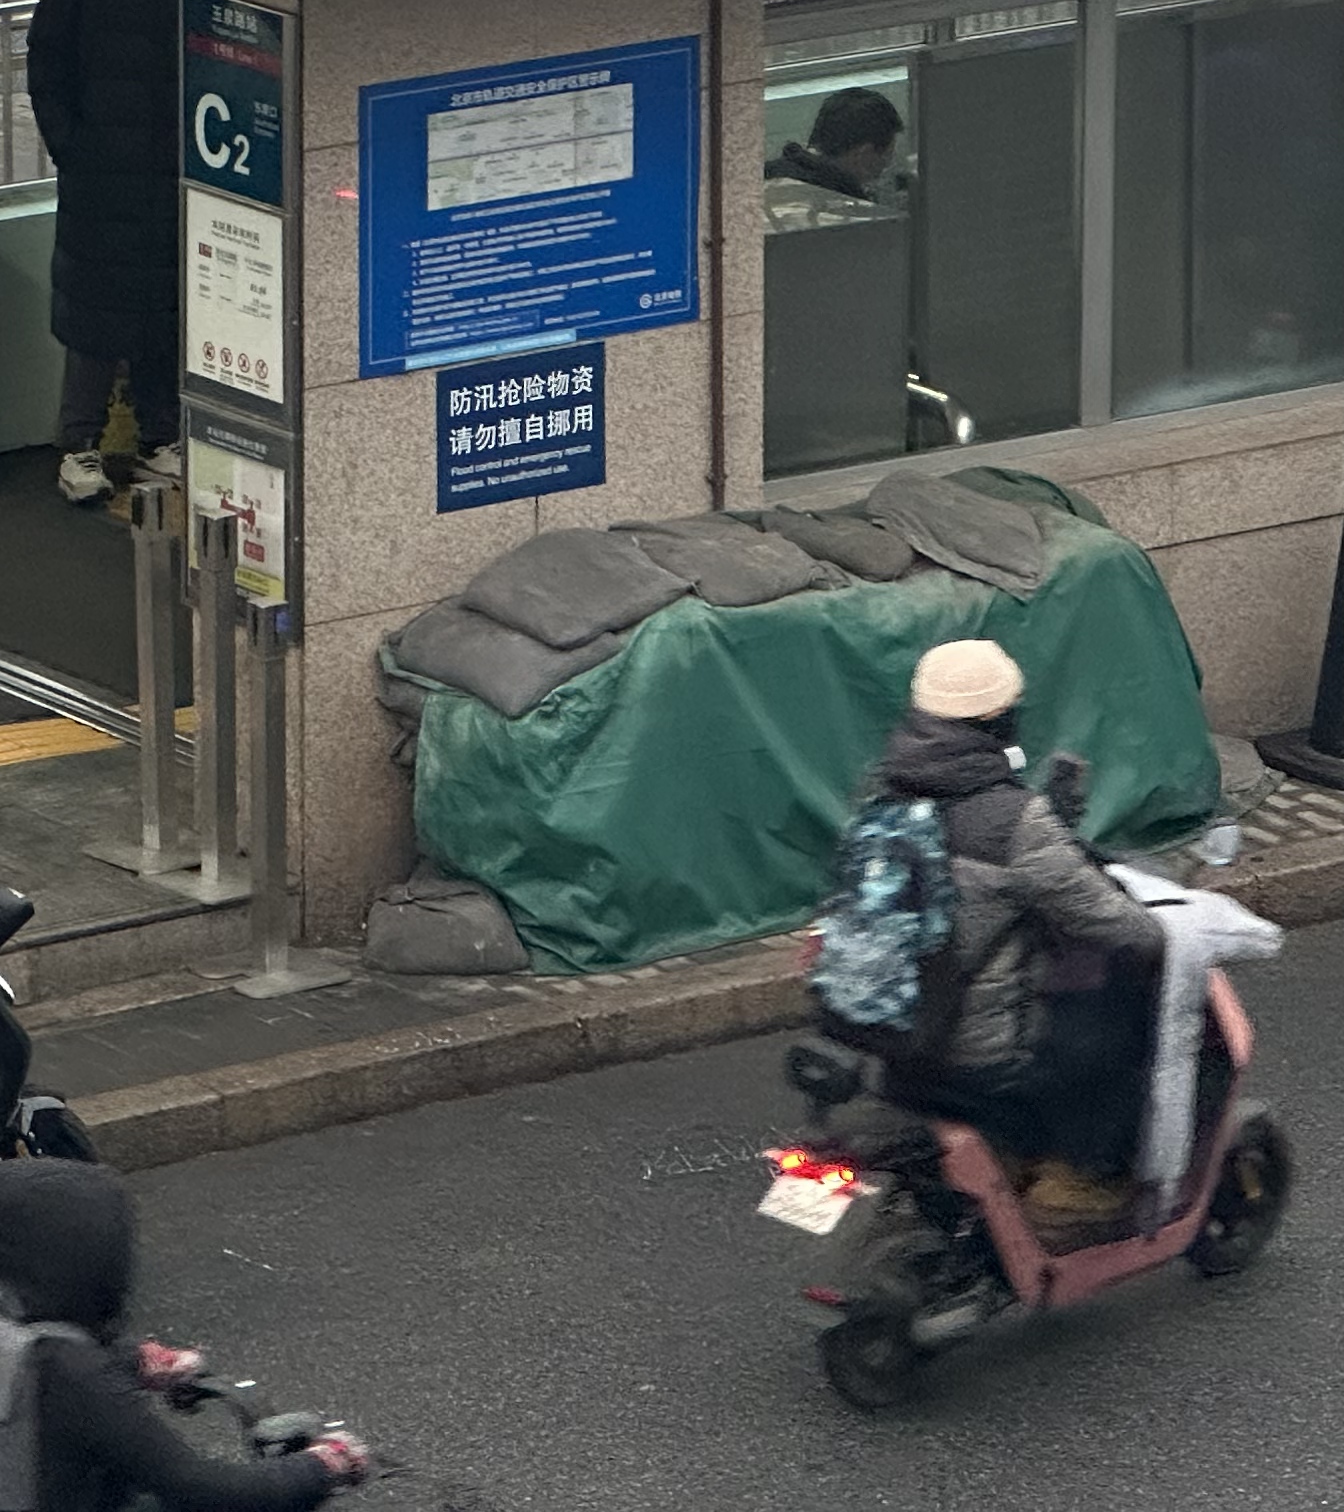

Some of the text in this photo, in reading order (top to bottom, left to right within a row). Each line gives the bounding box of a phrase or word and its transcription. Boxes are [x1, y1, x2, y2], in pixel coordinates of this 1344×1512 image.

[194, 92, 251, 176] C2
[449, 365, 593, 417] 防汛抢险物资
[449, 404, 593, 456] 请勿擅自挪用
[487, 476, 500, 486] No
[503, 457, 519, 468] and
